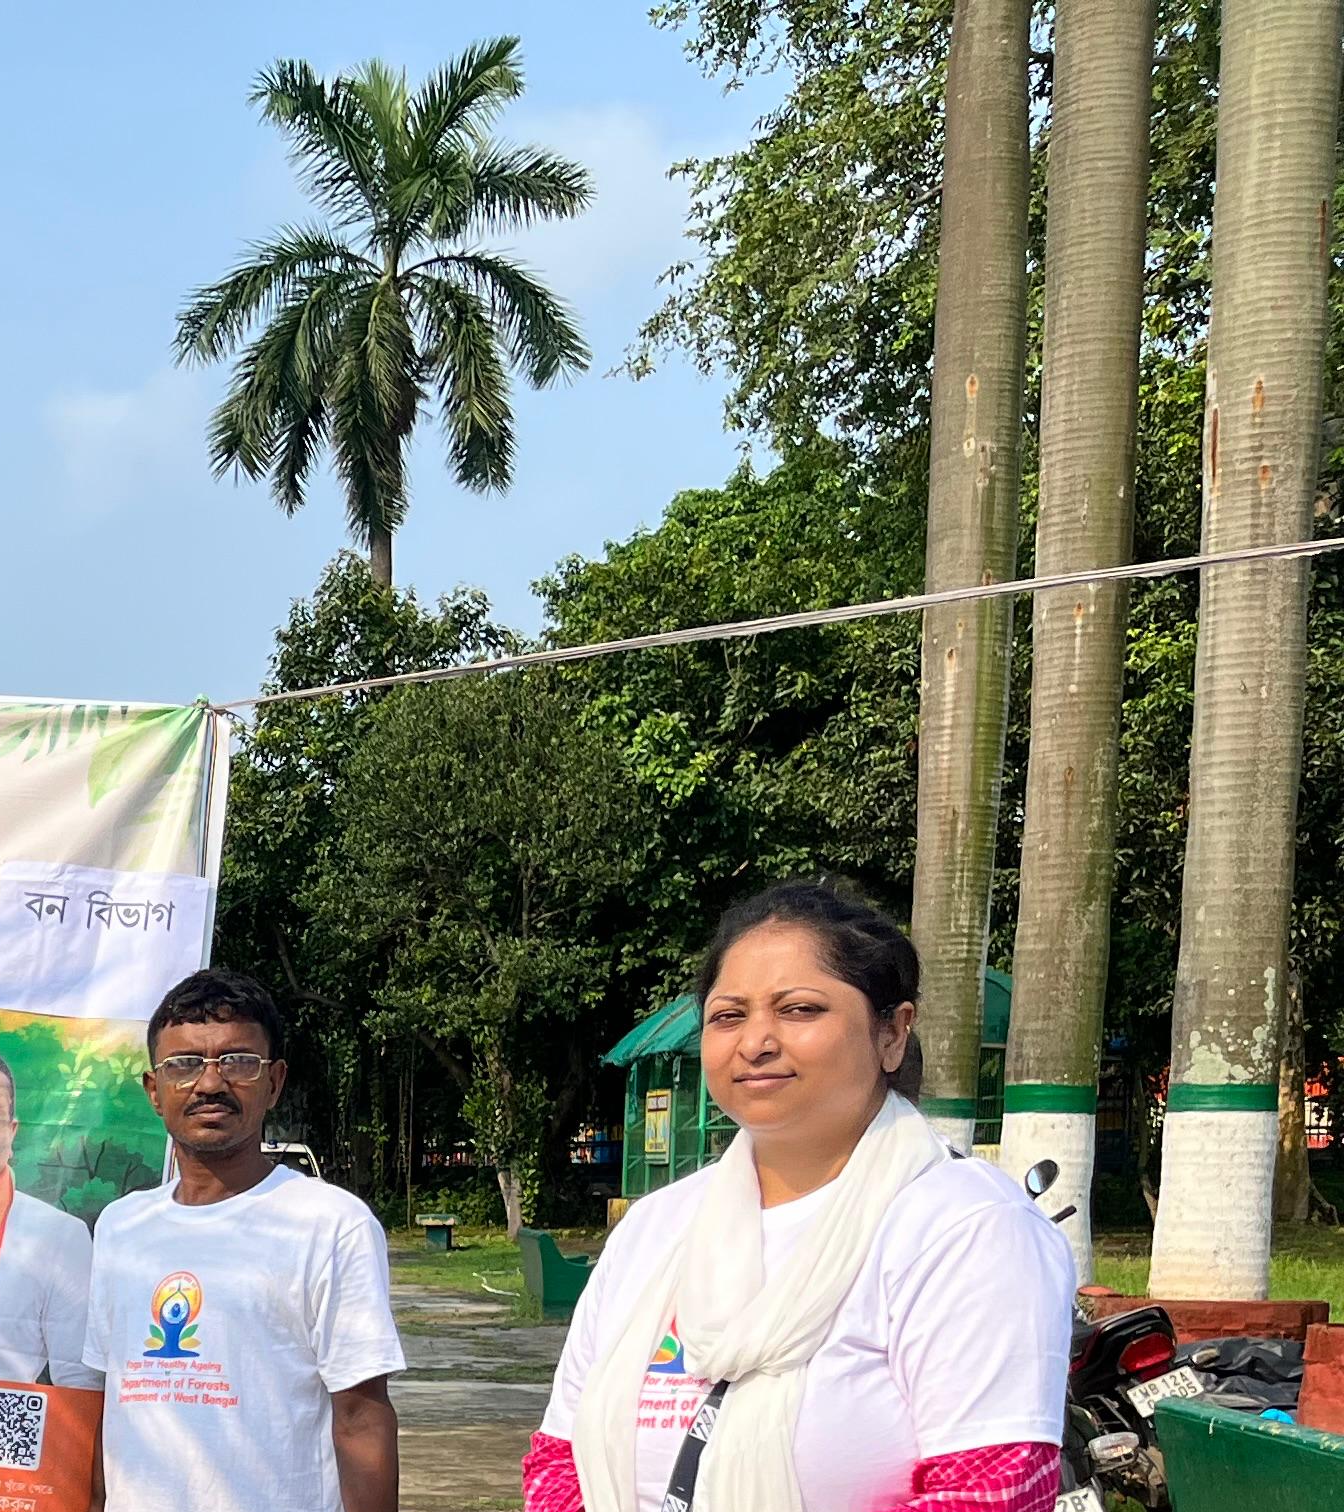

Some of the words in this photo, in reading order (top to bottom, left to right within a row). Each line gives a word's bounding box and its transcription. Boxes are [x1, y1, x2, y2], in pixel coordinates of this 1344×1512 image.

[24, 891, 70, 924] বন
[86, 890, 176, 931] বিভাগ
[173, 1379, 185, 1389] of
[187, 1378, 230, 1391] Forests
[173, 1392, 199, 1403] West
[202, 1394, 238, 1408] Bengal
[680, 1396, 699, 1411] of
